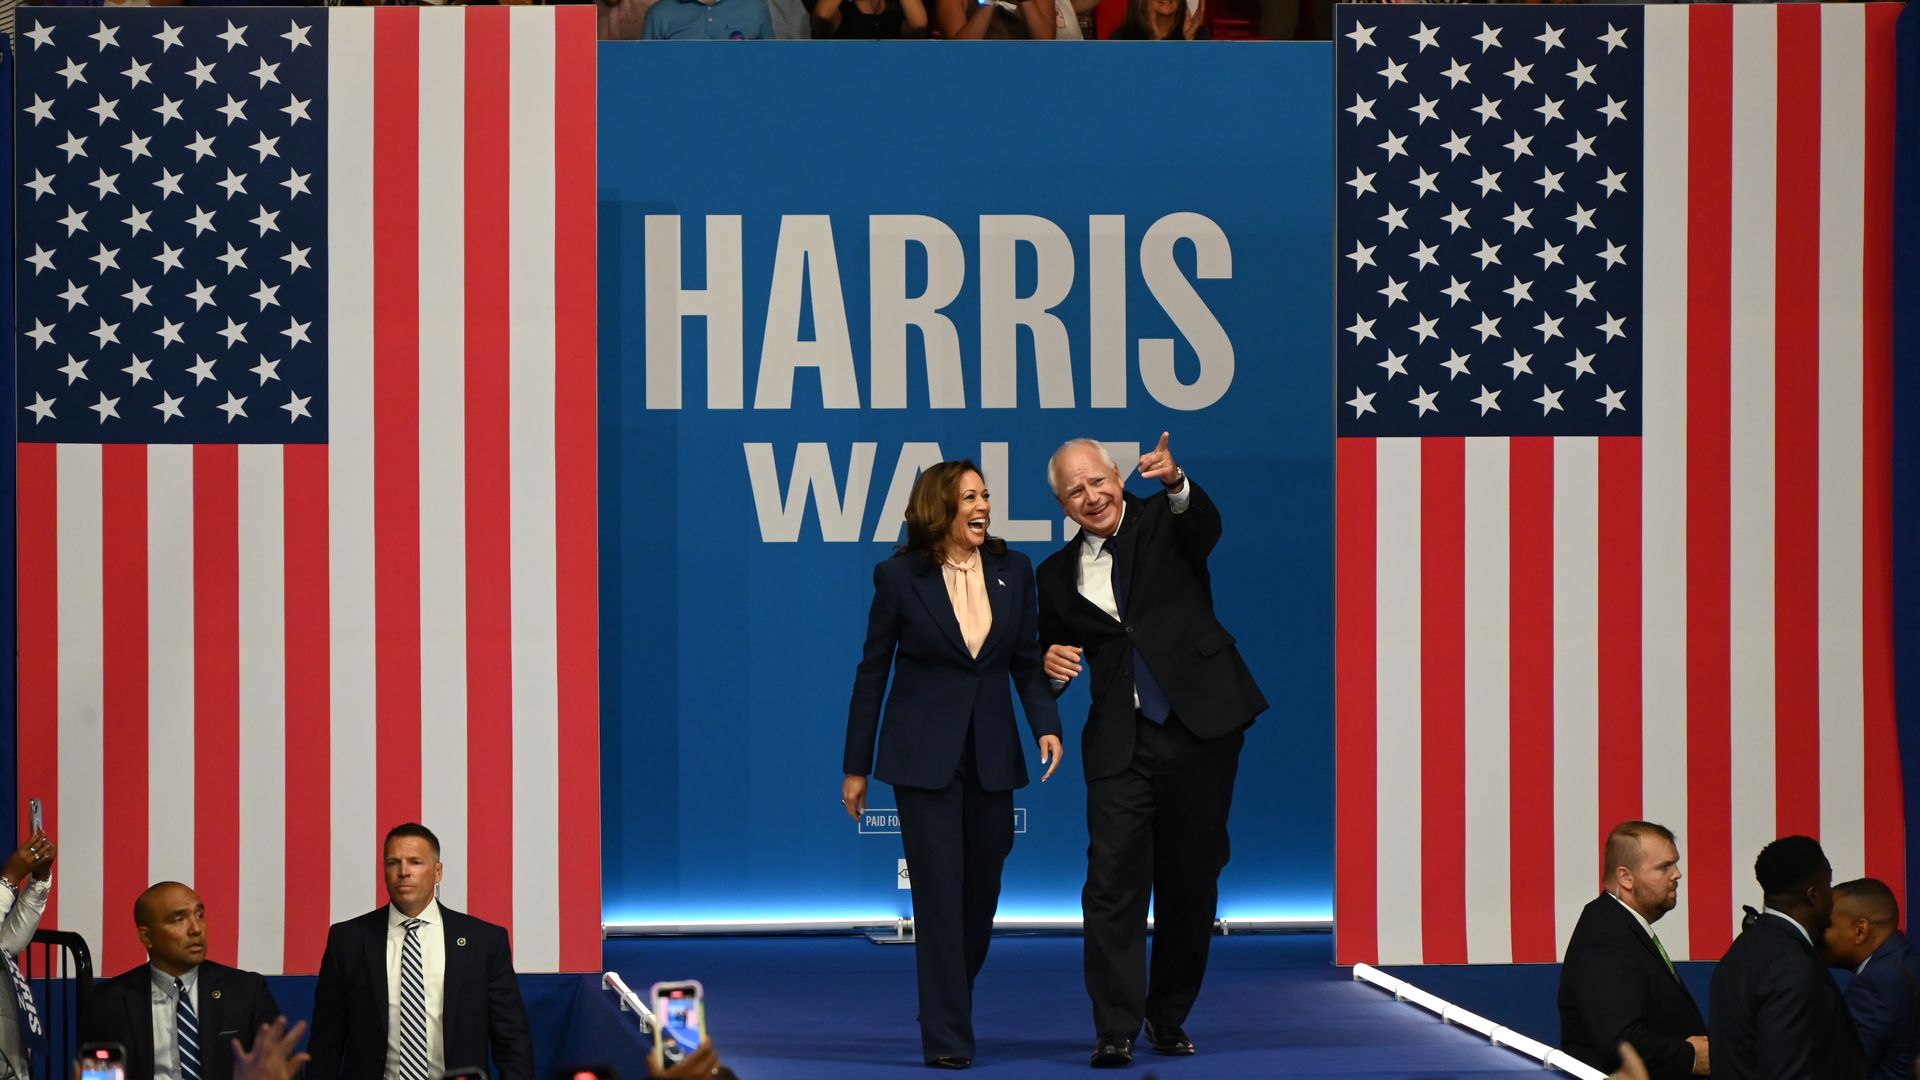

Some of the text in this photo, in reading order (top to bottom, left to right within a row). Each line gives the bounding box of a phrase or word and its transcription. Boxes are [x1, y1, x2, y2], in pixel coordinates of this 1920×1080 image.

[644, 211, 1236, 411] HARRIS
[865, 815, 901, 827] PAID FO
